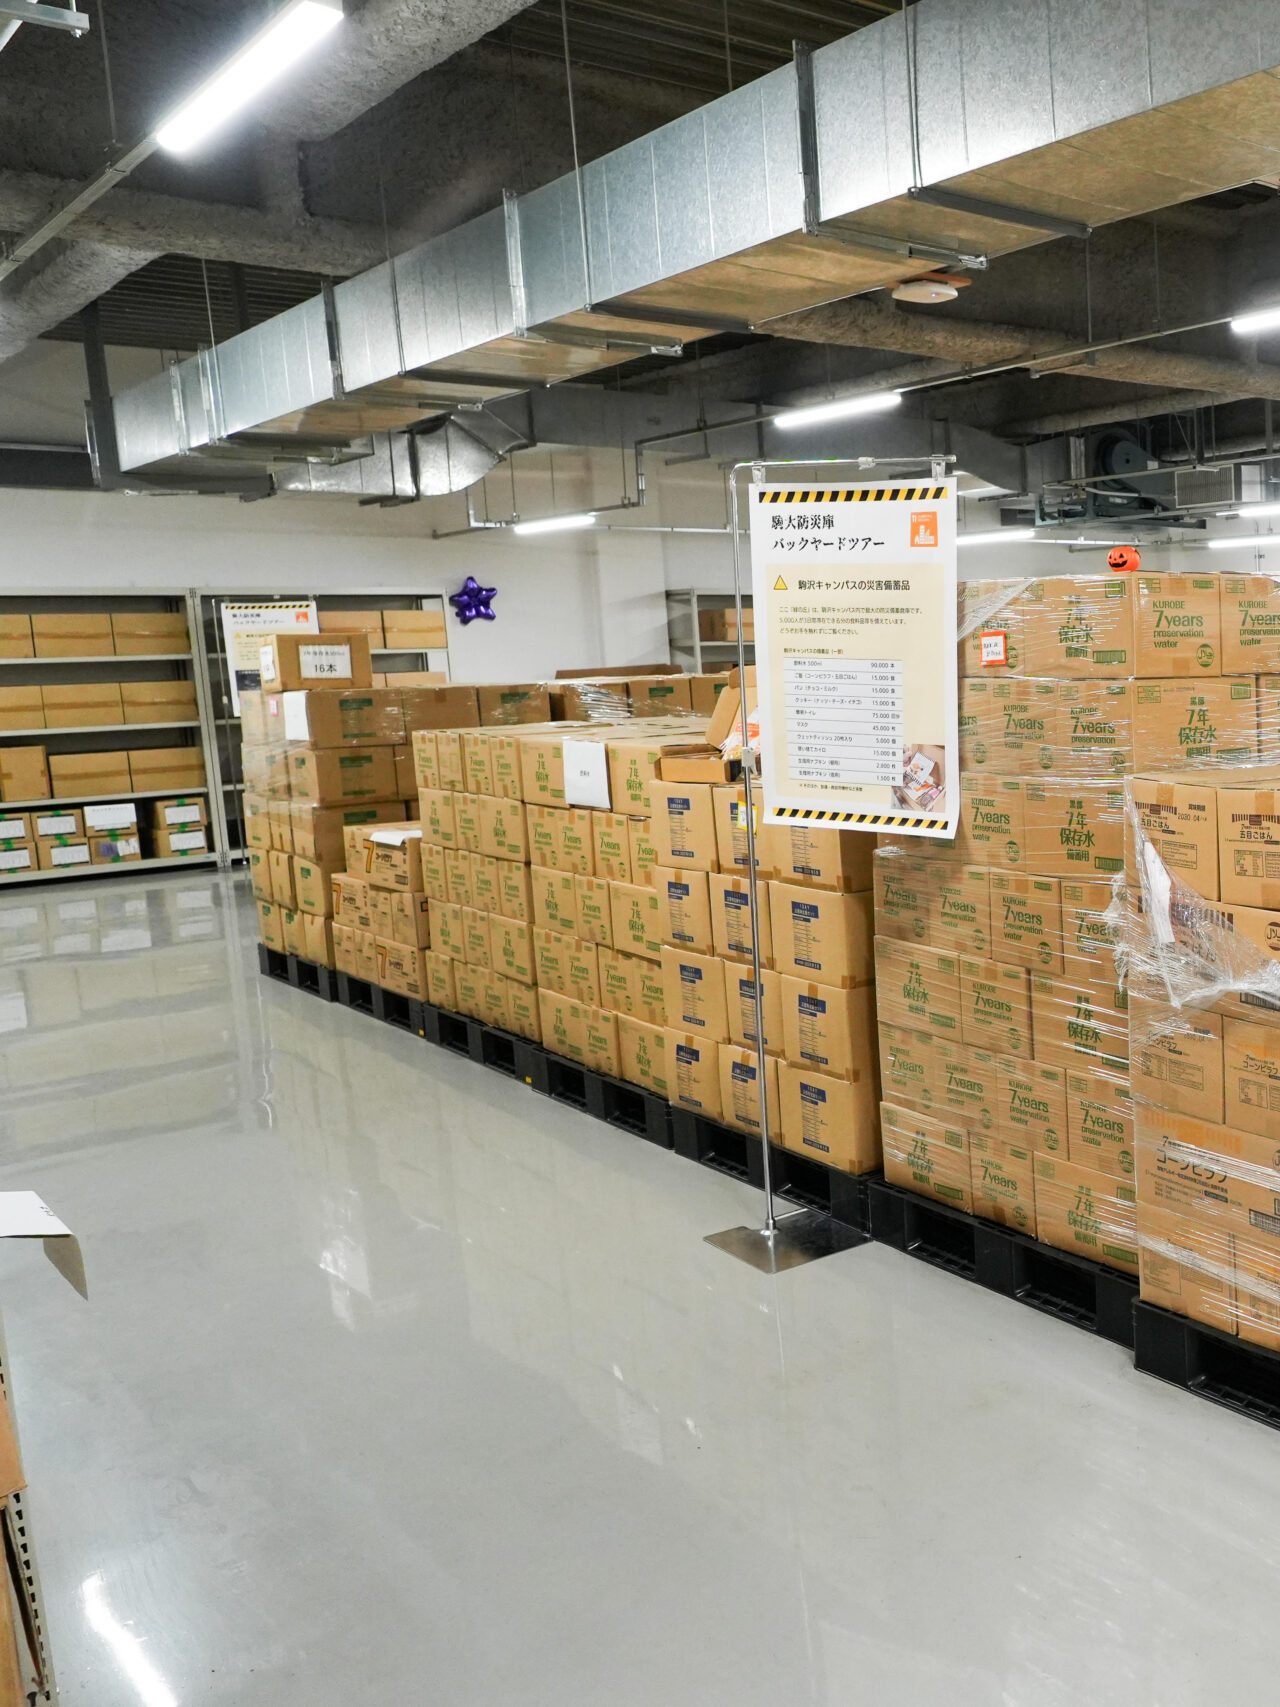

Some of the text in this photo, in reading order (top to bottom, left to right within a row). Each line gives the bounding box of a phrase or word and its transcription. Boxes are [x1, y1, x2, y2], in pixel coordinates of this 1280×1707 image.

[772, 515, 834, 530] 駒大防災庫
[772, 537, 885, 551] バックヤードツアー
[798, 580, 910, 591] 駒沢キャンパスの災害備蓄品
[1152, 601, 1185, 609] KUROBE
[1238, 600, 1268, 608] KUROBE
[1153, 610, 1203, 628] 7years
[1154, 640, 1178, 648] water
[1178, 726, 1217, 745] 保存水
[971, 807, 1010, 824] 7years
[1068, 812, 1087, 828] 7年
[1060, 828, 1095, 847] 保存水
[1240, 831, 1273, 840] 五目ごはん
[1003, 896, 1028, 907] KUROBE
[1003, 904, 1042, 926] 7years
[1243, 1061, 1278, 1075] コーンピラフ
[1010, 1089, 1049, 1113] 7years
[1082, 1108, 1124, 1134] 7years
